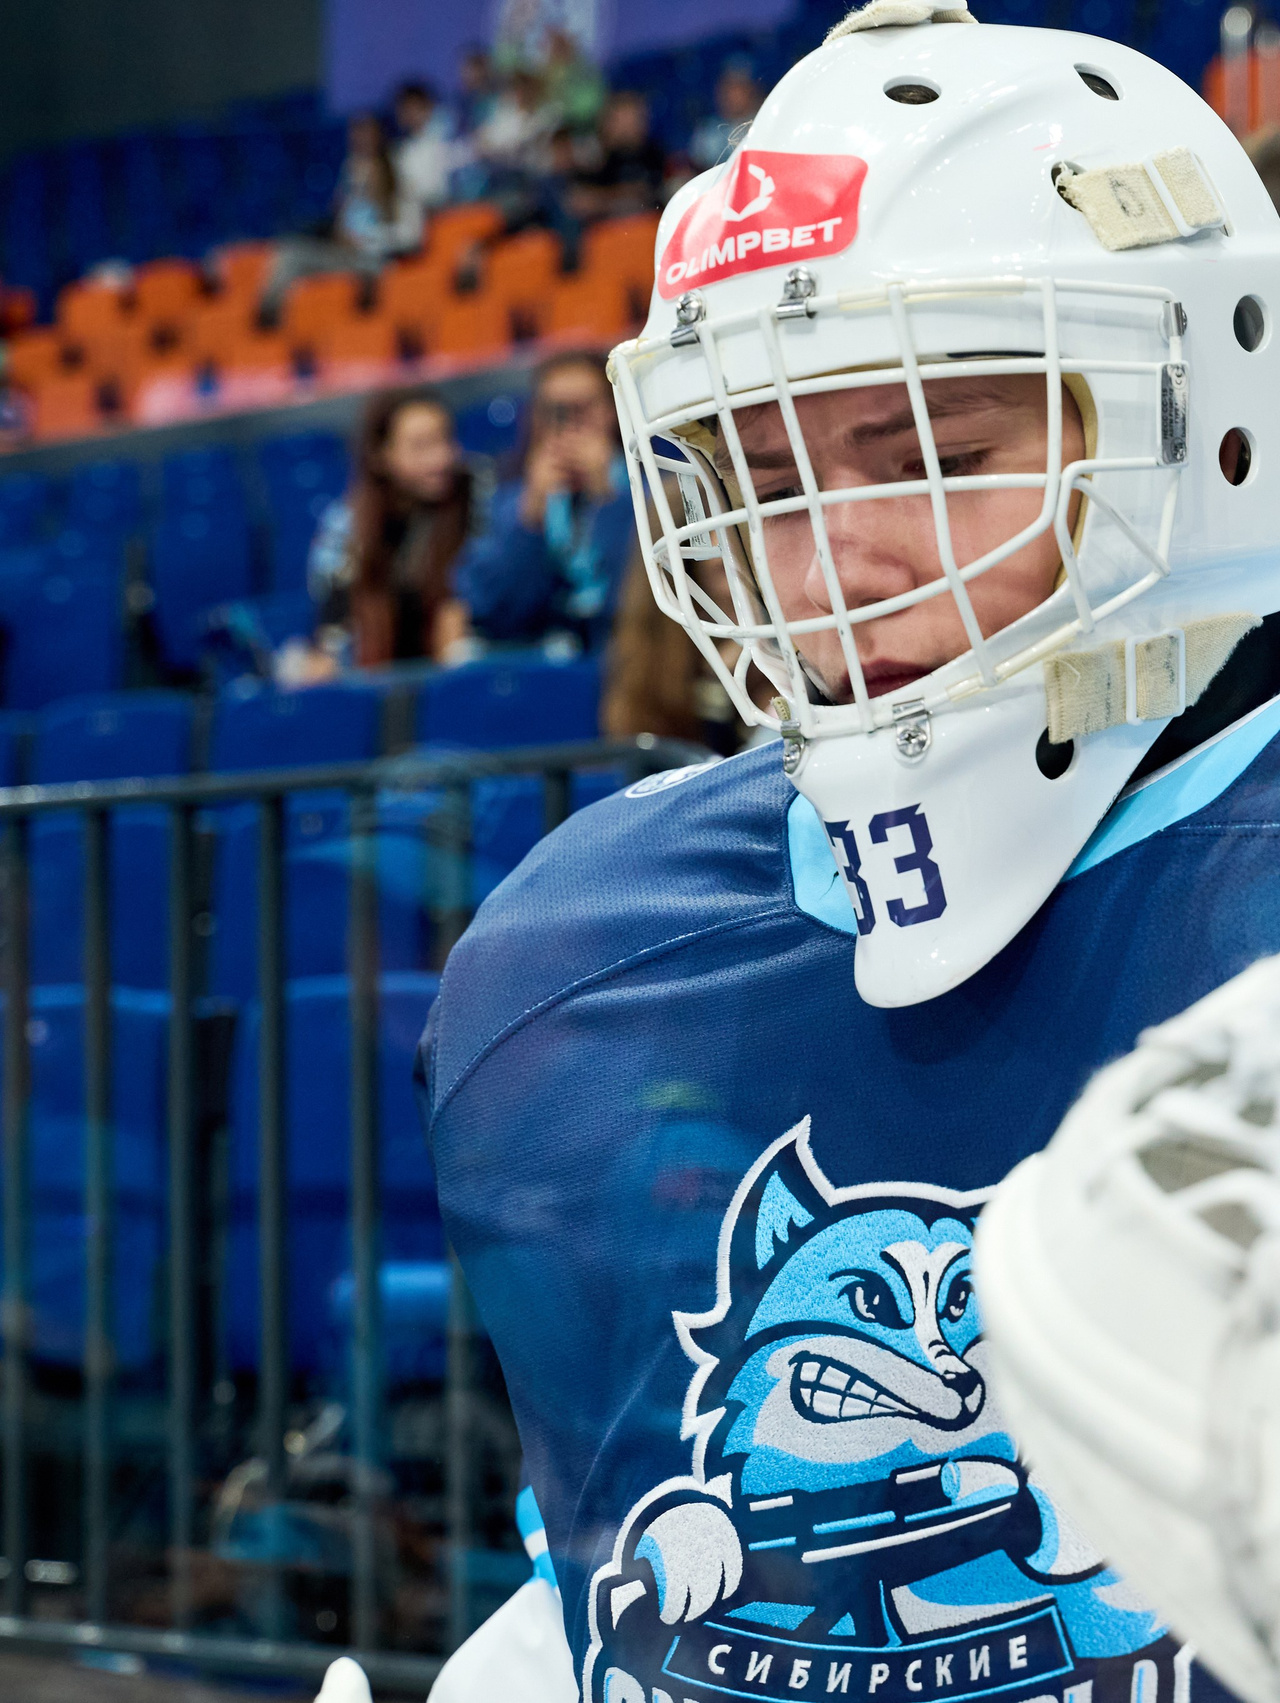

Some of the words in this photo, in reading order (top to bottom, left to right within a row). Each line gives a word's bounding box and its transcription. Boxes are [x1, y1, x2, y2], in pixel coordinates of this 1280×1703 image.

[665, 216, 843, 286] OLIMPBET
[824, 802, 948, 937] 33
[707, 1634, 1028, 1694] СИБИРСКИЕ
